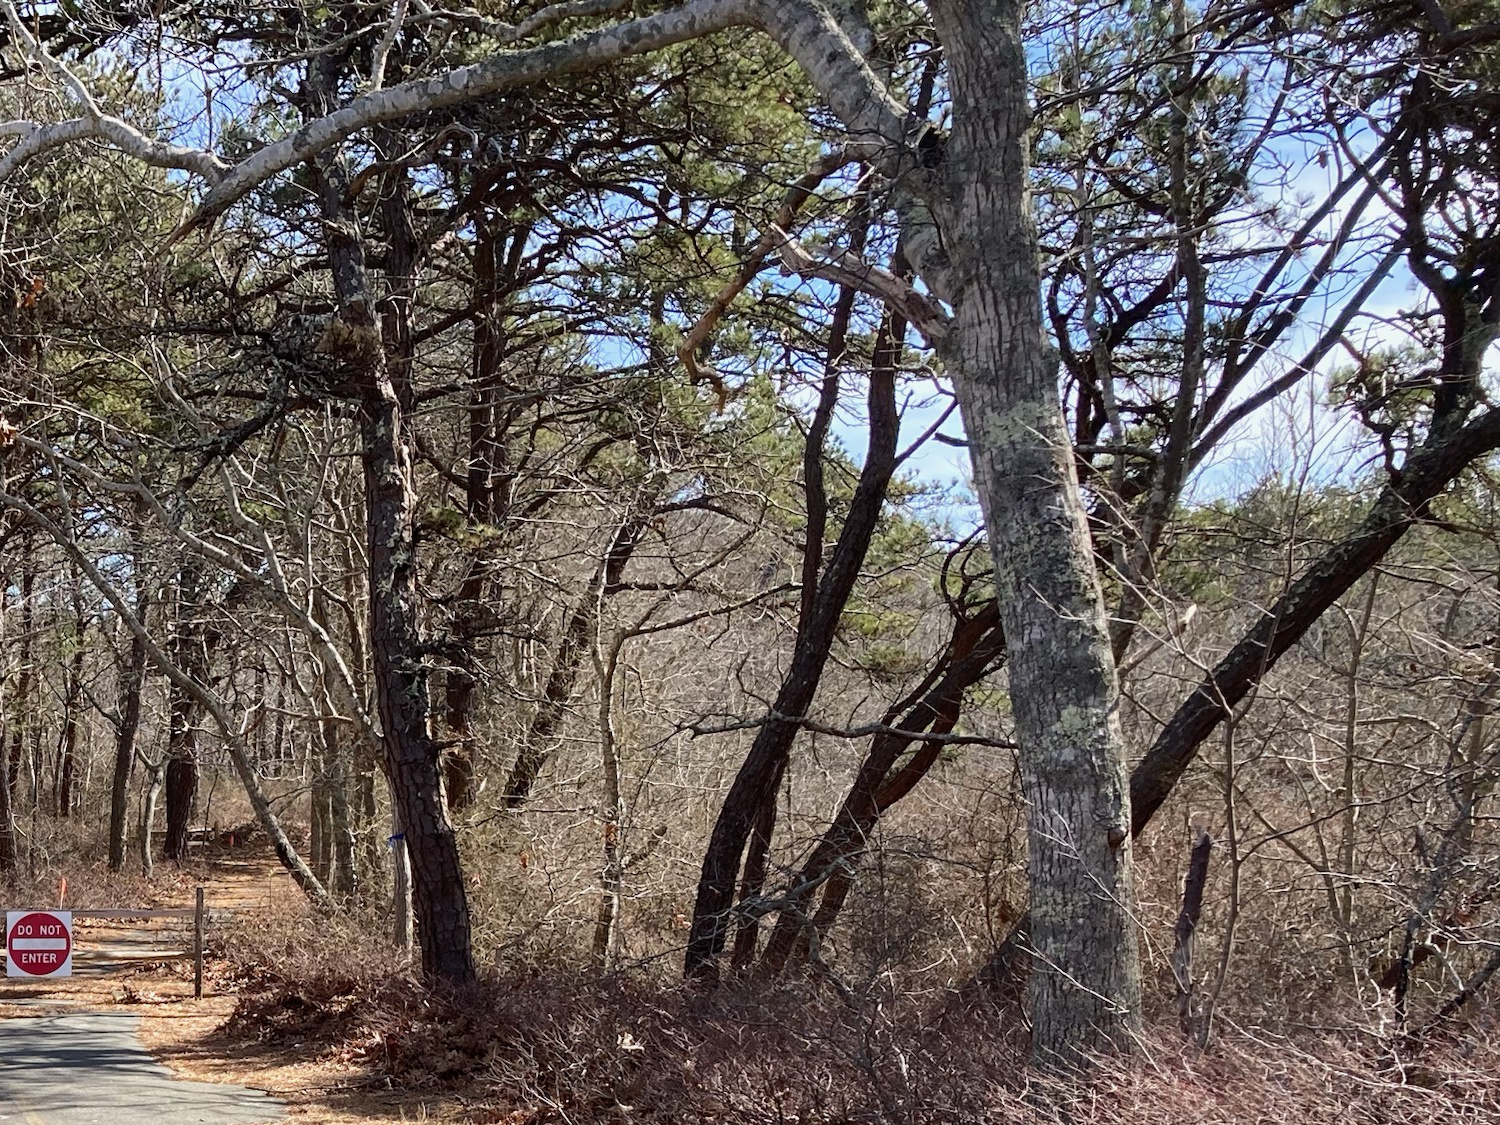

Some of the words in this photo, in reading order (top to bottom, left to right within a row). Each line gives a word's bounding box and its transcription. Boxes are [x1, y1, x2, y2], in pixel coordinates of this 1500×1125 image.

[17, 925, 32, 935] DO
[40, 925, 62, 935] NOT
[22, 953, 57, 964] ENTER
